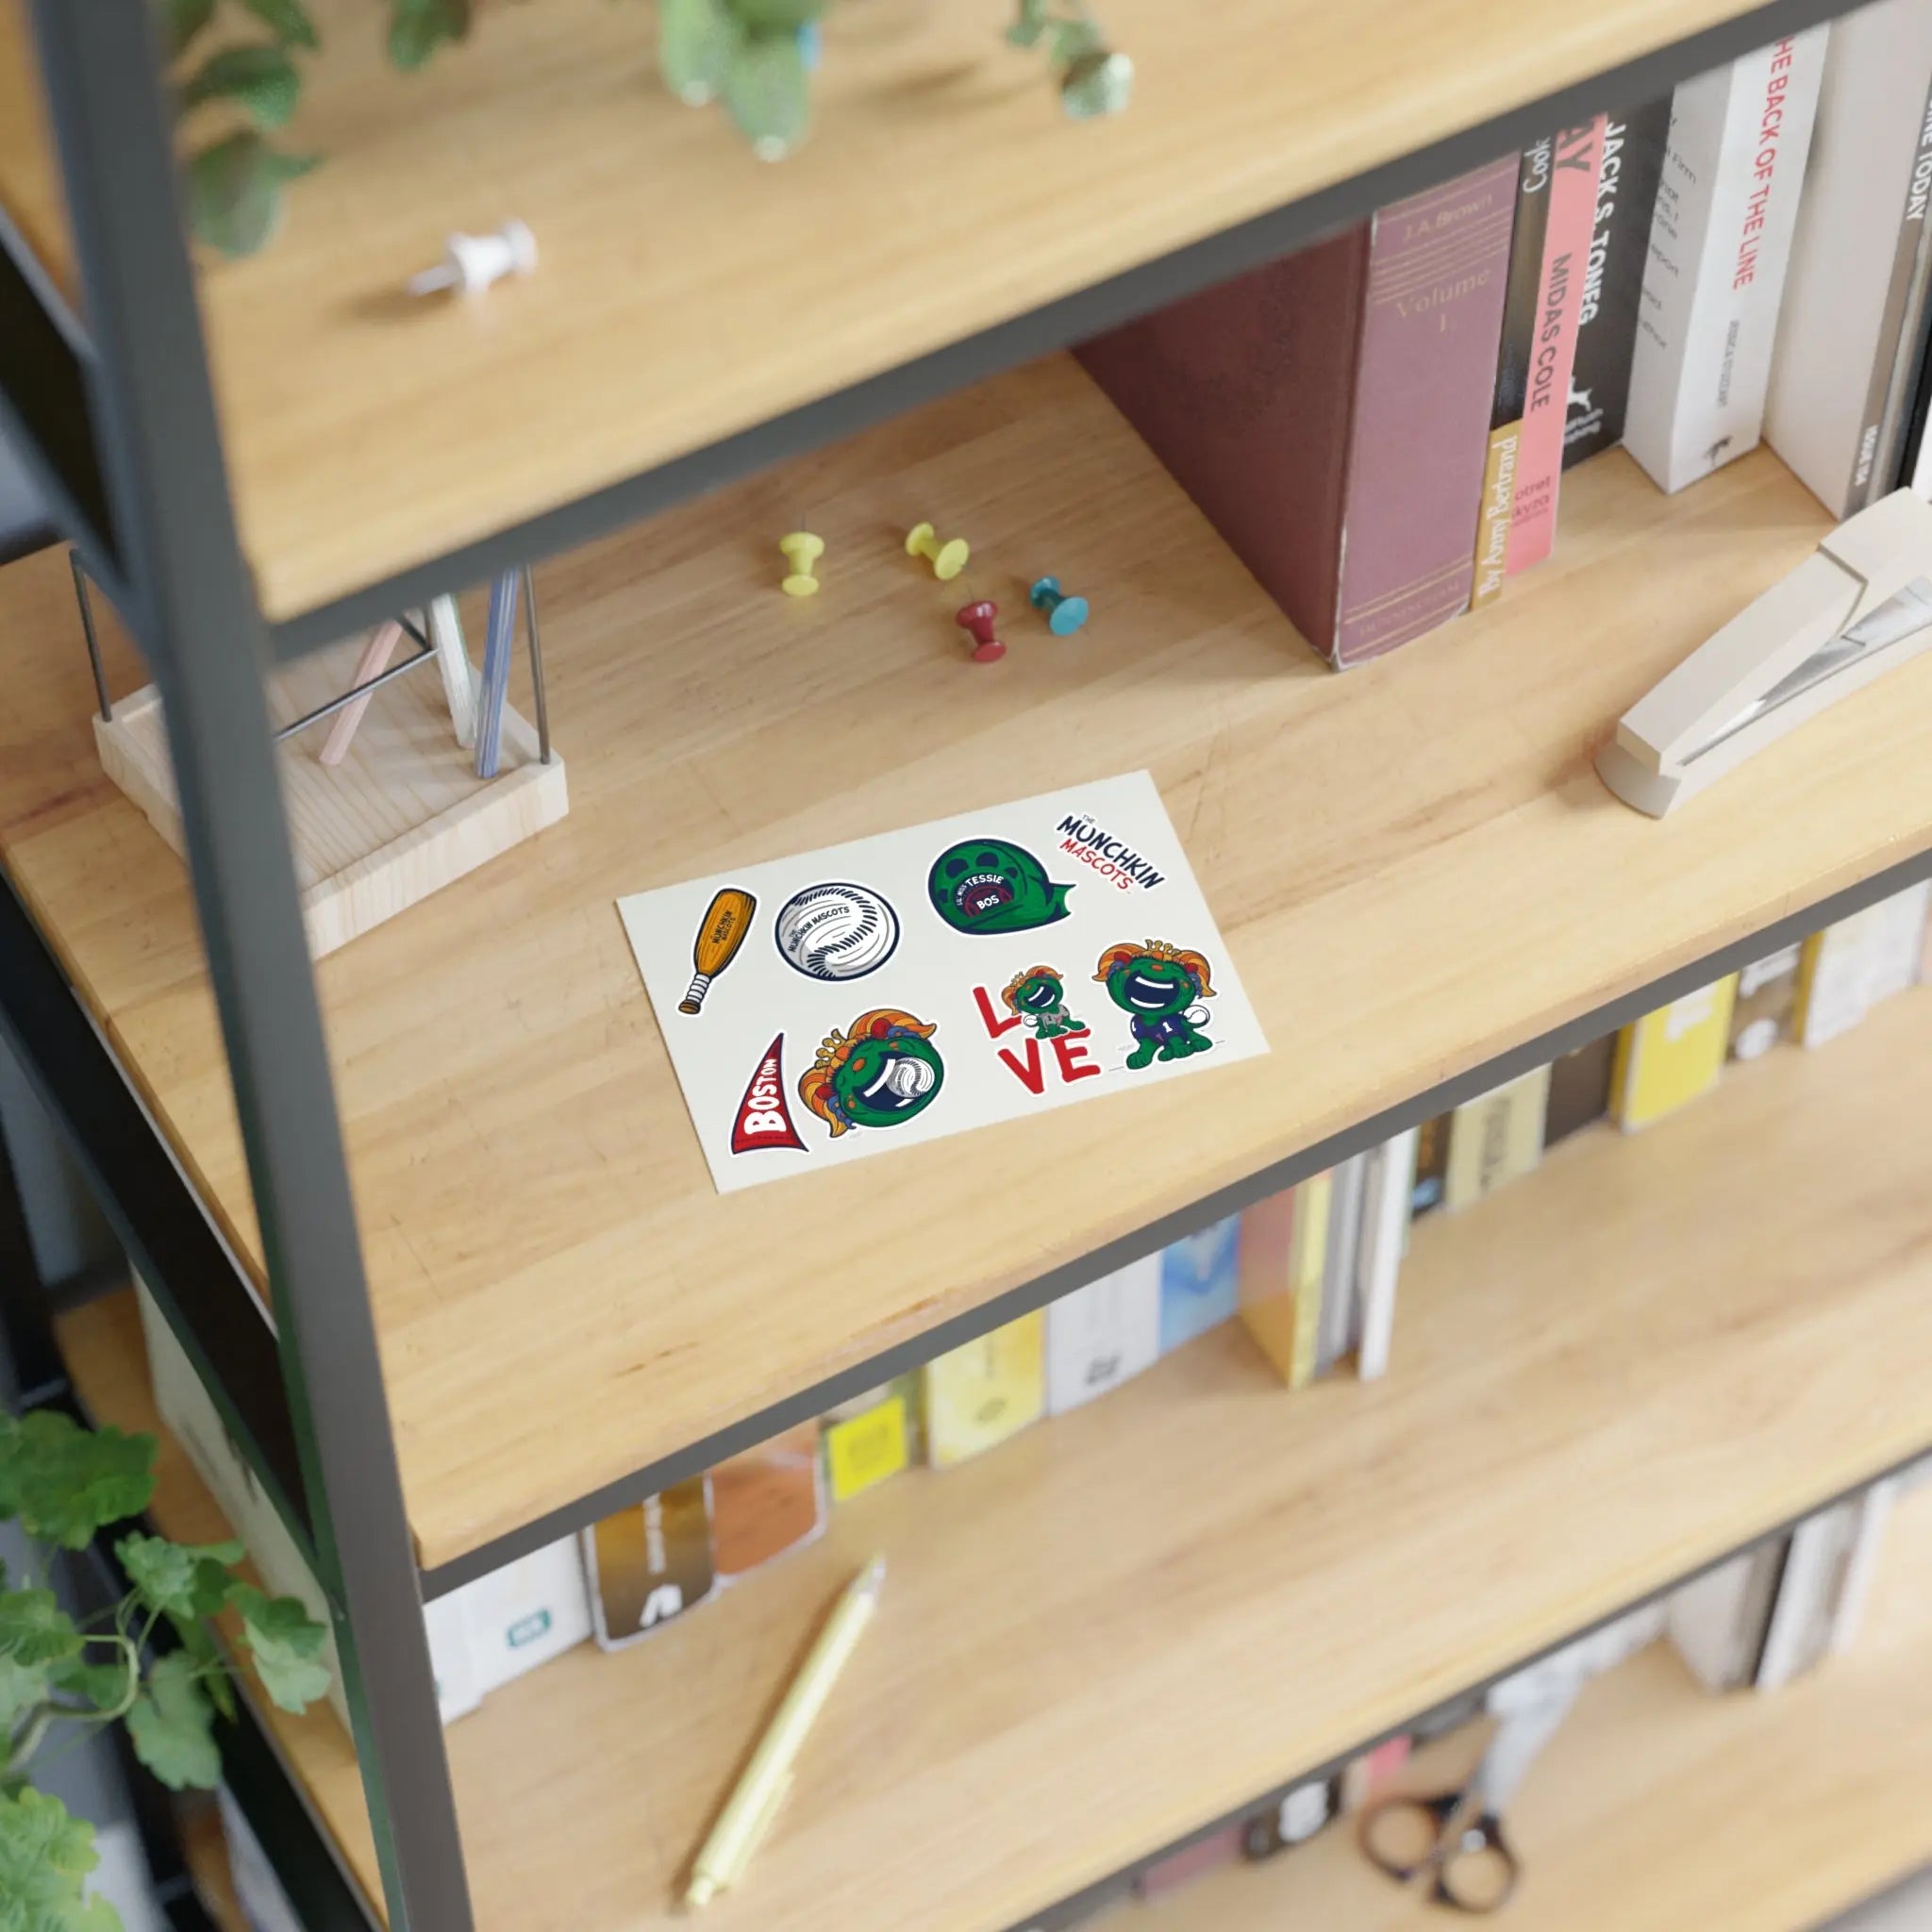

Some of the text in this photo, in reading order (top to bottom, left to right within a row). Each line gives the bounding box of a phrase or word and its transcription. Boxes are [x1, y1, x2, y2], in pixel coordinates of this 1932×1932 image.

[1758, 75, 1789, 145] BACK
[1597, 121, 1627, 199] JACK
[1753, 147, 1776, 180] OF
[1743, 184, 1771, 236] THE
[1577, 229, 1609, 326] TONEG
[1732, 235, 1761, 291] LINE
[1395, 268, 1491, 319] Volume
[1530, 252, 1573, 412] MIDAS COLE
[1081, 814, 1096, 825] THE
[1056, 814, 1166, 890] MUNCHKIN
[1058, 838, 1134, 891] MASCOTS
[964, 874, 1005, 887] TESSIE
[975, 894, 1000, 910] BOS
[711, 909, 733, 944] MUNCHKIN
[787, 906, 850, 954] MUNCHKIN MASCOTS
[743, 1058, 788, 1135] BOSTON
